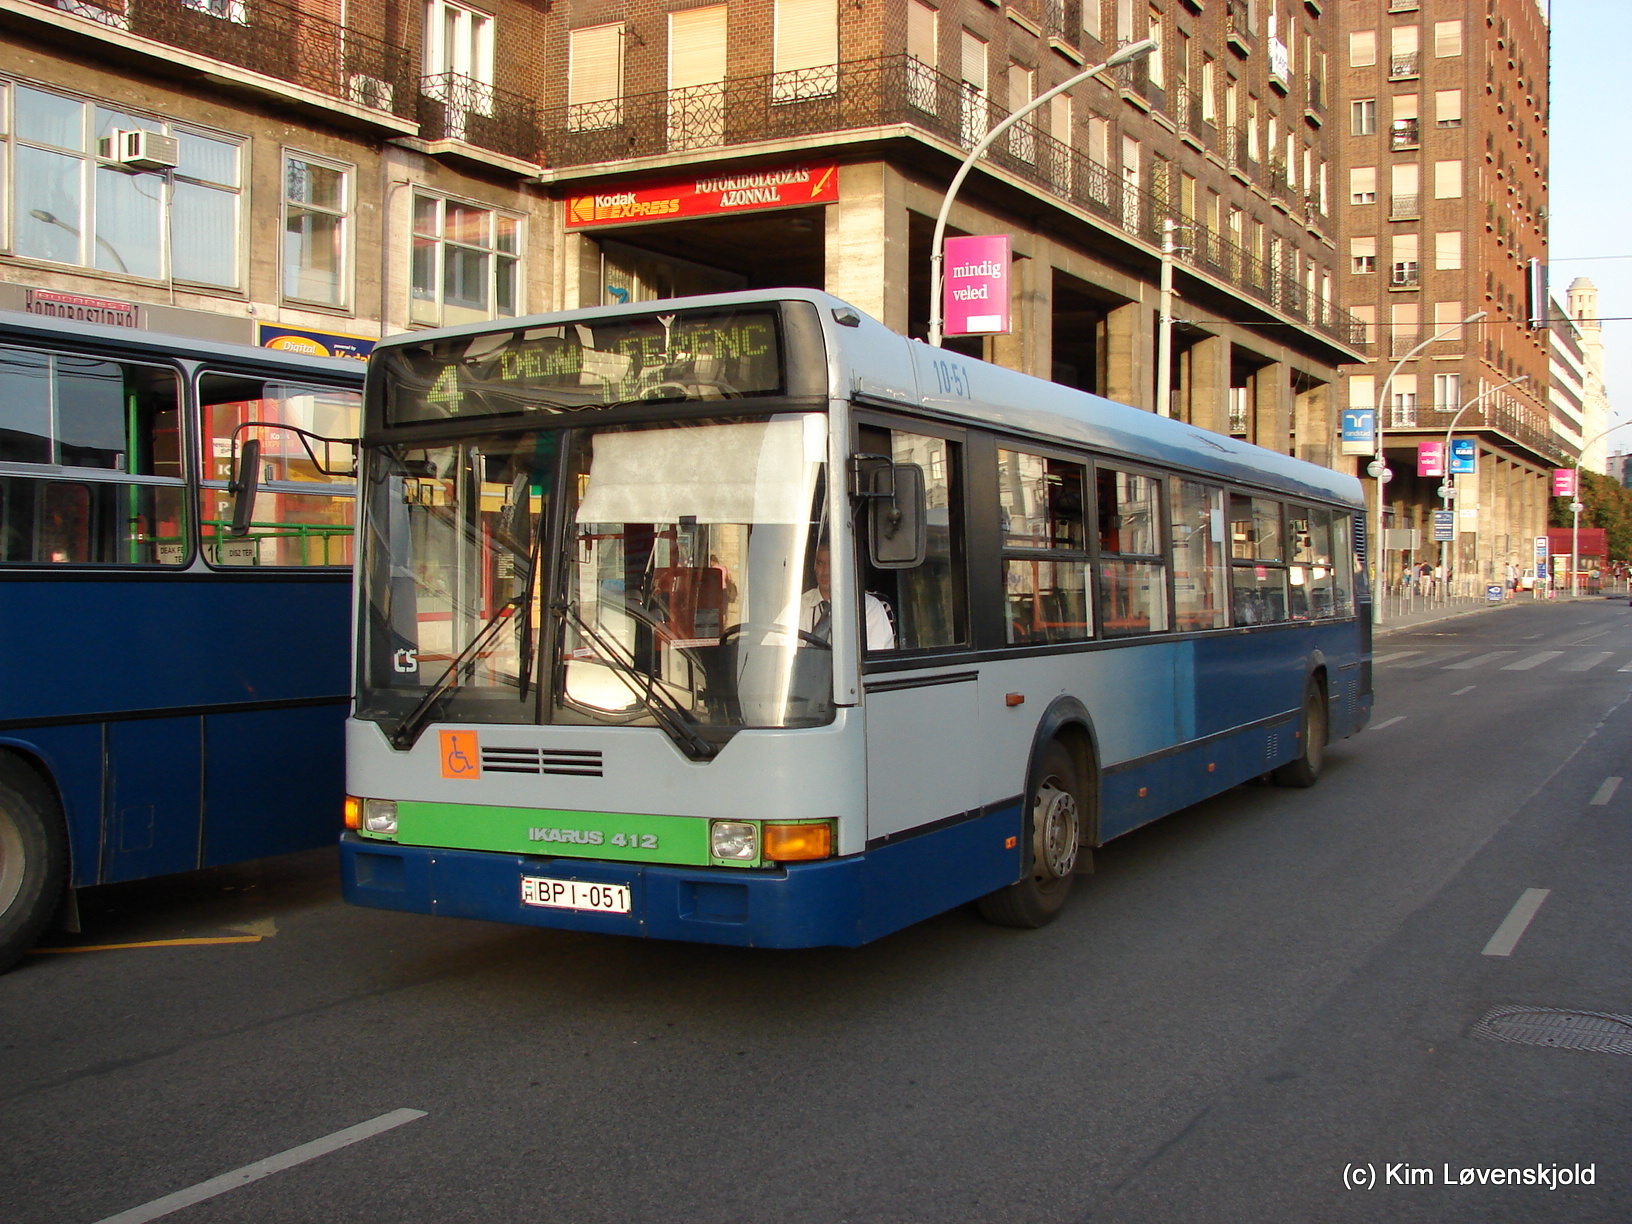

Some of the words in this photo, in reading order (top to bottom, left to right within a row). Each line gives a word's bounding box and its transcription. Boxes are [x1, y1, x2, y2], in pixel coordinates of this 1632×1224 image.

[595, 191, 636, 208] Kodak
[719, 186, 780, 207] AZONNAL
[606, 198, 680, 219] EXPRESS
[952, 261, 1002, 279] mindig
[952, 284, 988, 301] veled
[283, 341, 316, 354] Digital
[427, 364, 464, 413] 4
[528, 827, 605, 845] IKARUS
[611, 833, 659, 849] 412
[538, 882, 625, 909] BPI-051
